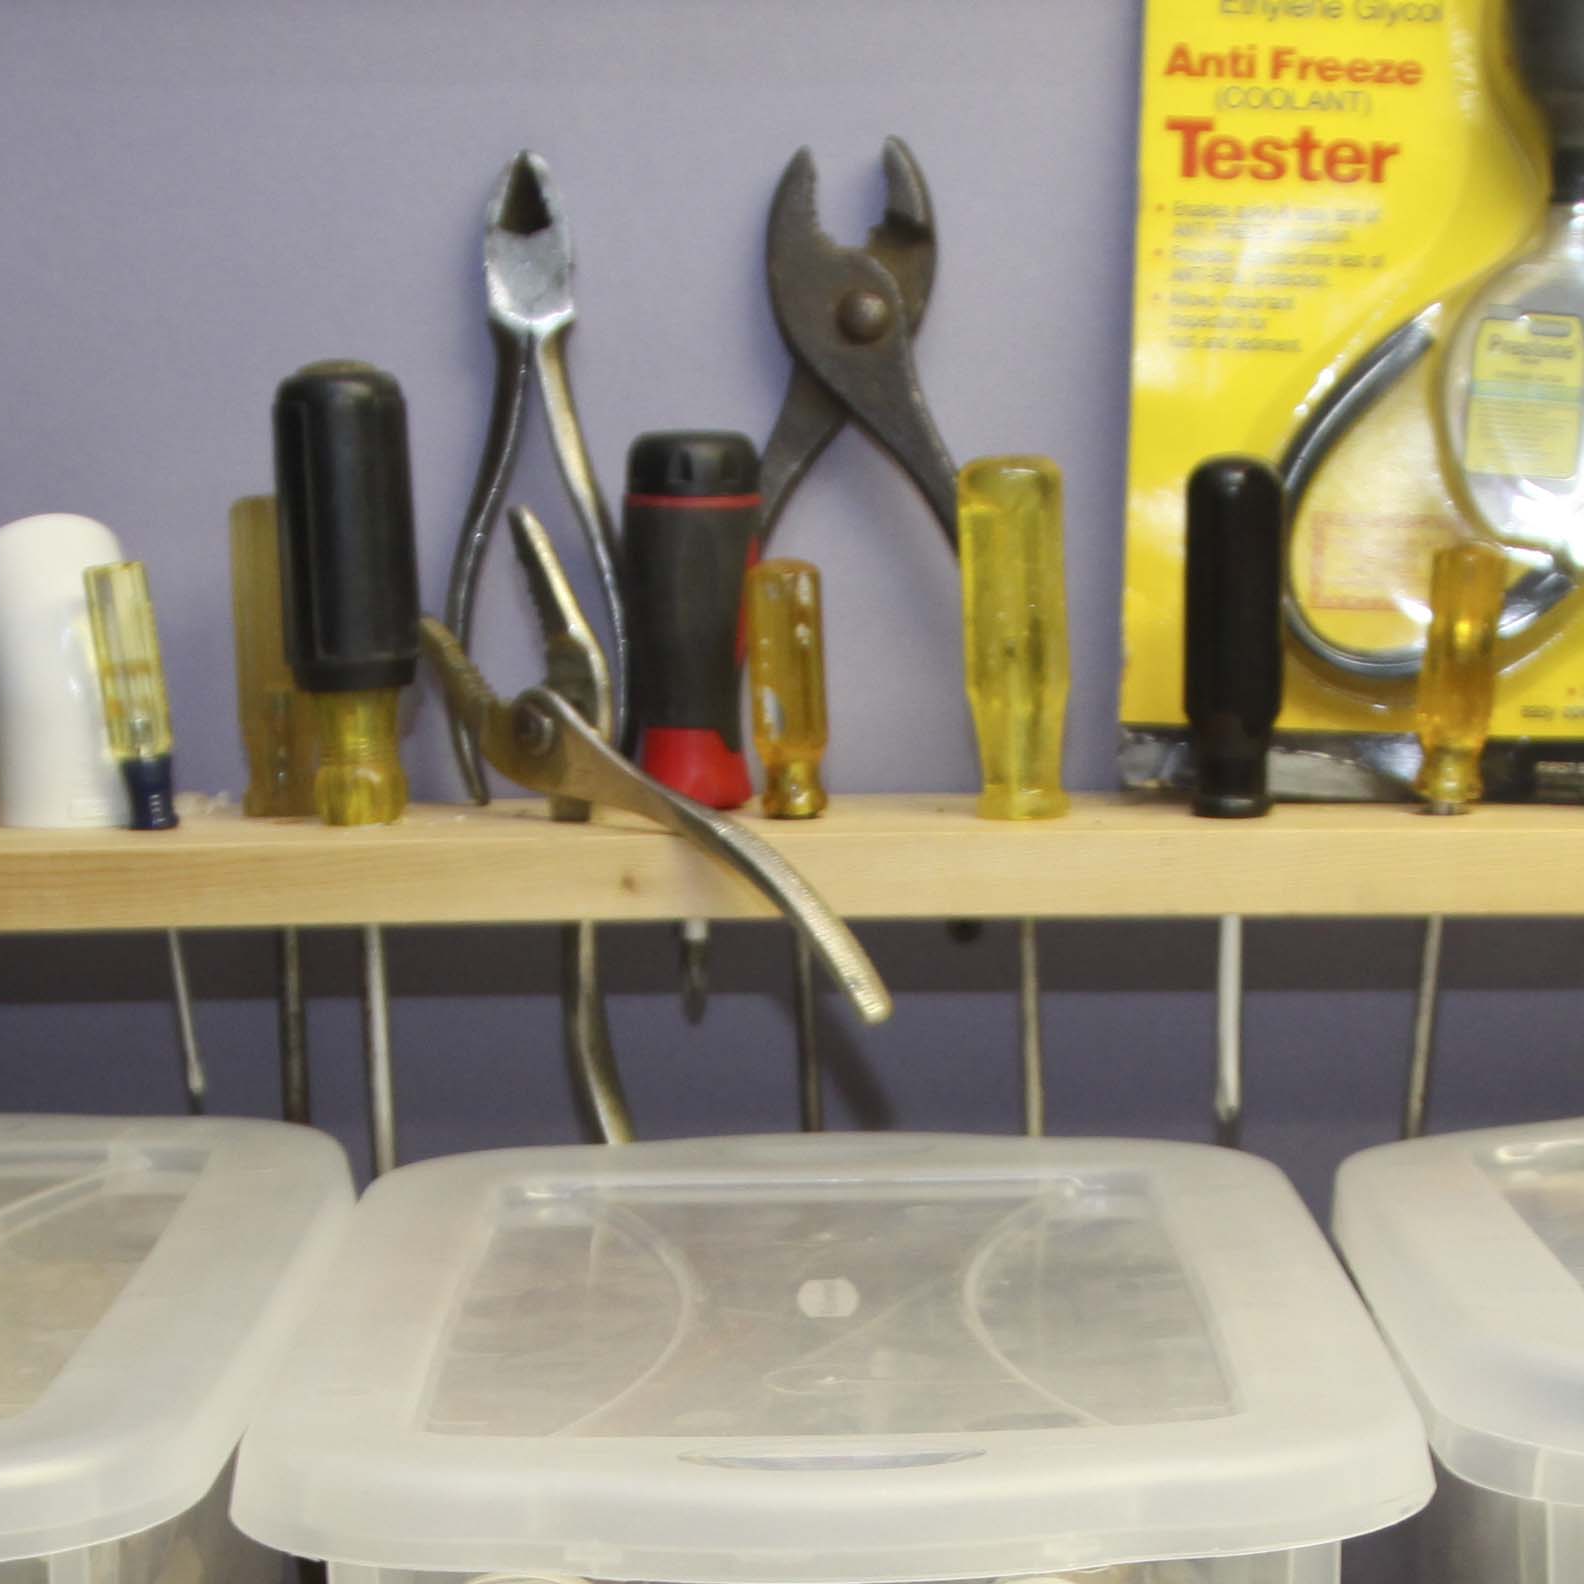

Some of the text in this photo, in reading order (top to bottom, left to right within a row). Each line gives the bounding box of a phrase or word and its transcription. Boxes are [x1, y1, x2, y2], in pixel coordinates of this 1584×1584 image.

[1163, 43, 1423, 84] Anti Freeze
[1215, 86, 1373, 114] (COOLANT)
[1165, 116, 1400, 183] Tester
